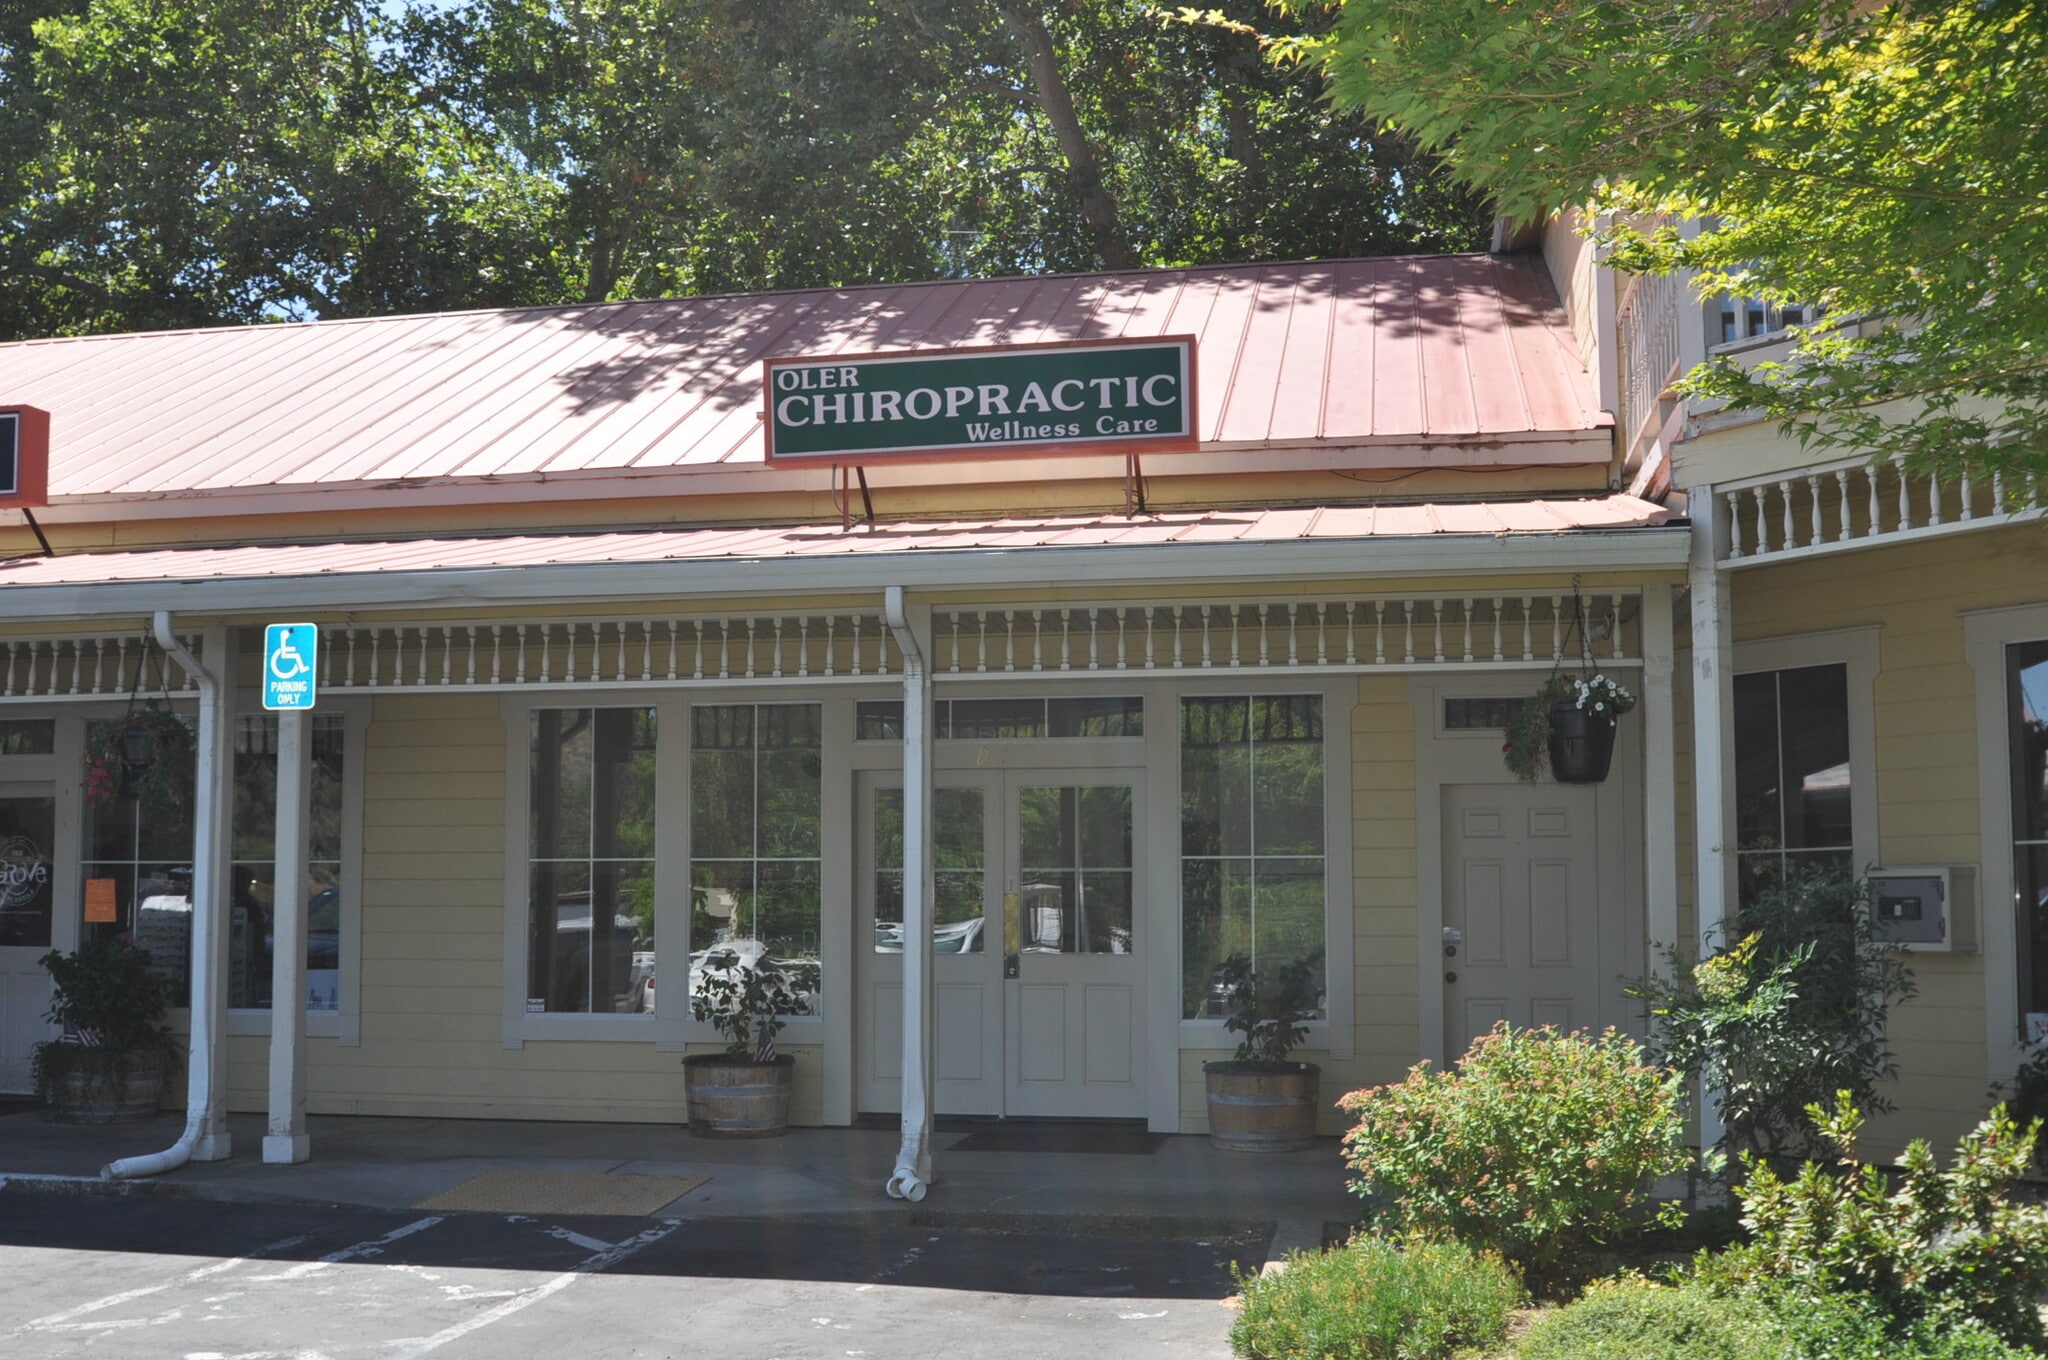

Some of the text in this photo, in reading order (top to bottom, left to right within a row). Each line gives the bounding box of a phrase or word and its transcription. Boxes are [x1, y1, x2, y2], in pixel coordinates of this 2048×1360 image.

[777, 366, 860, 392] OLER
[777, 374, 1177, 428] CHIROPRACTIC
[965, 415, 1158, 442] Wellness Care
[271, 681, 307, 693] PARKING
[277, 693, 300, 705] ONLY
